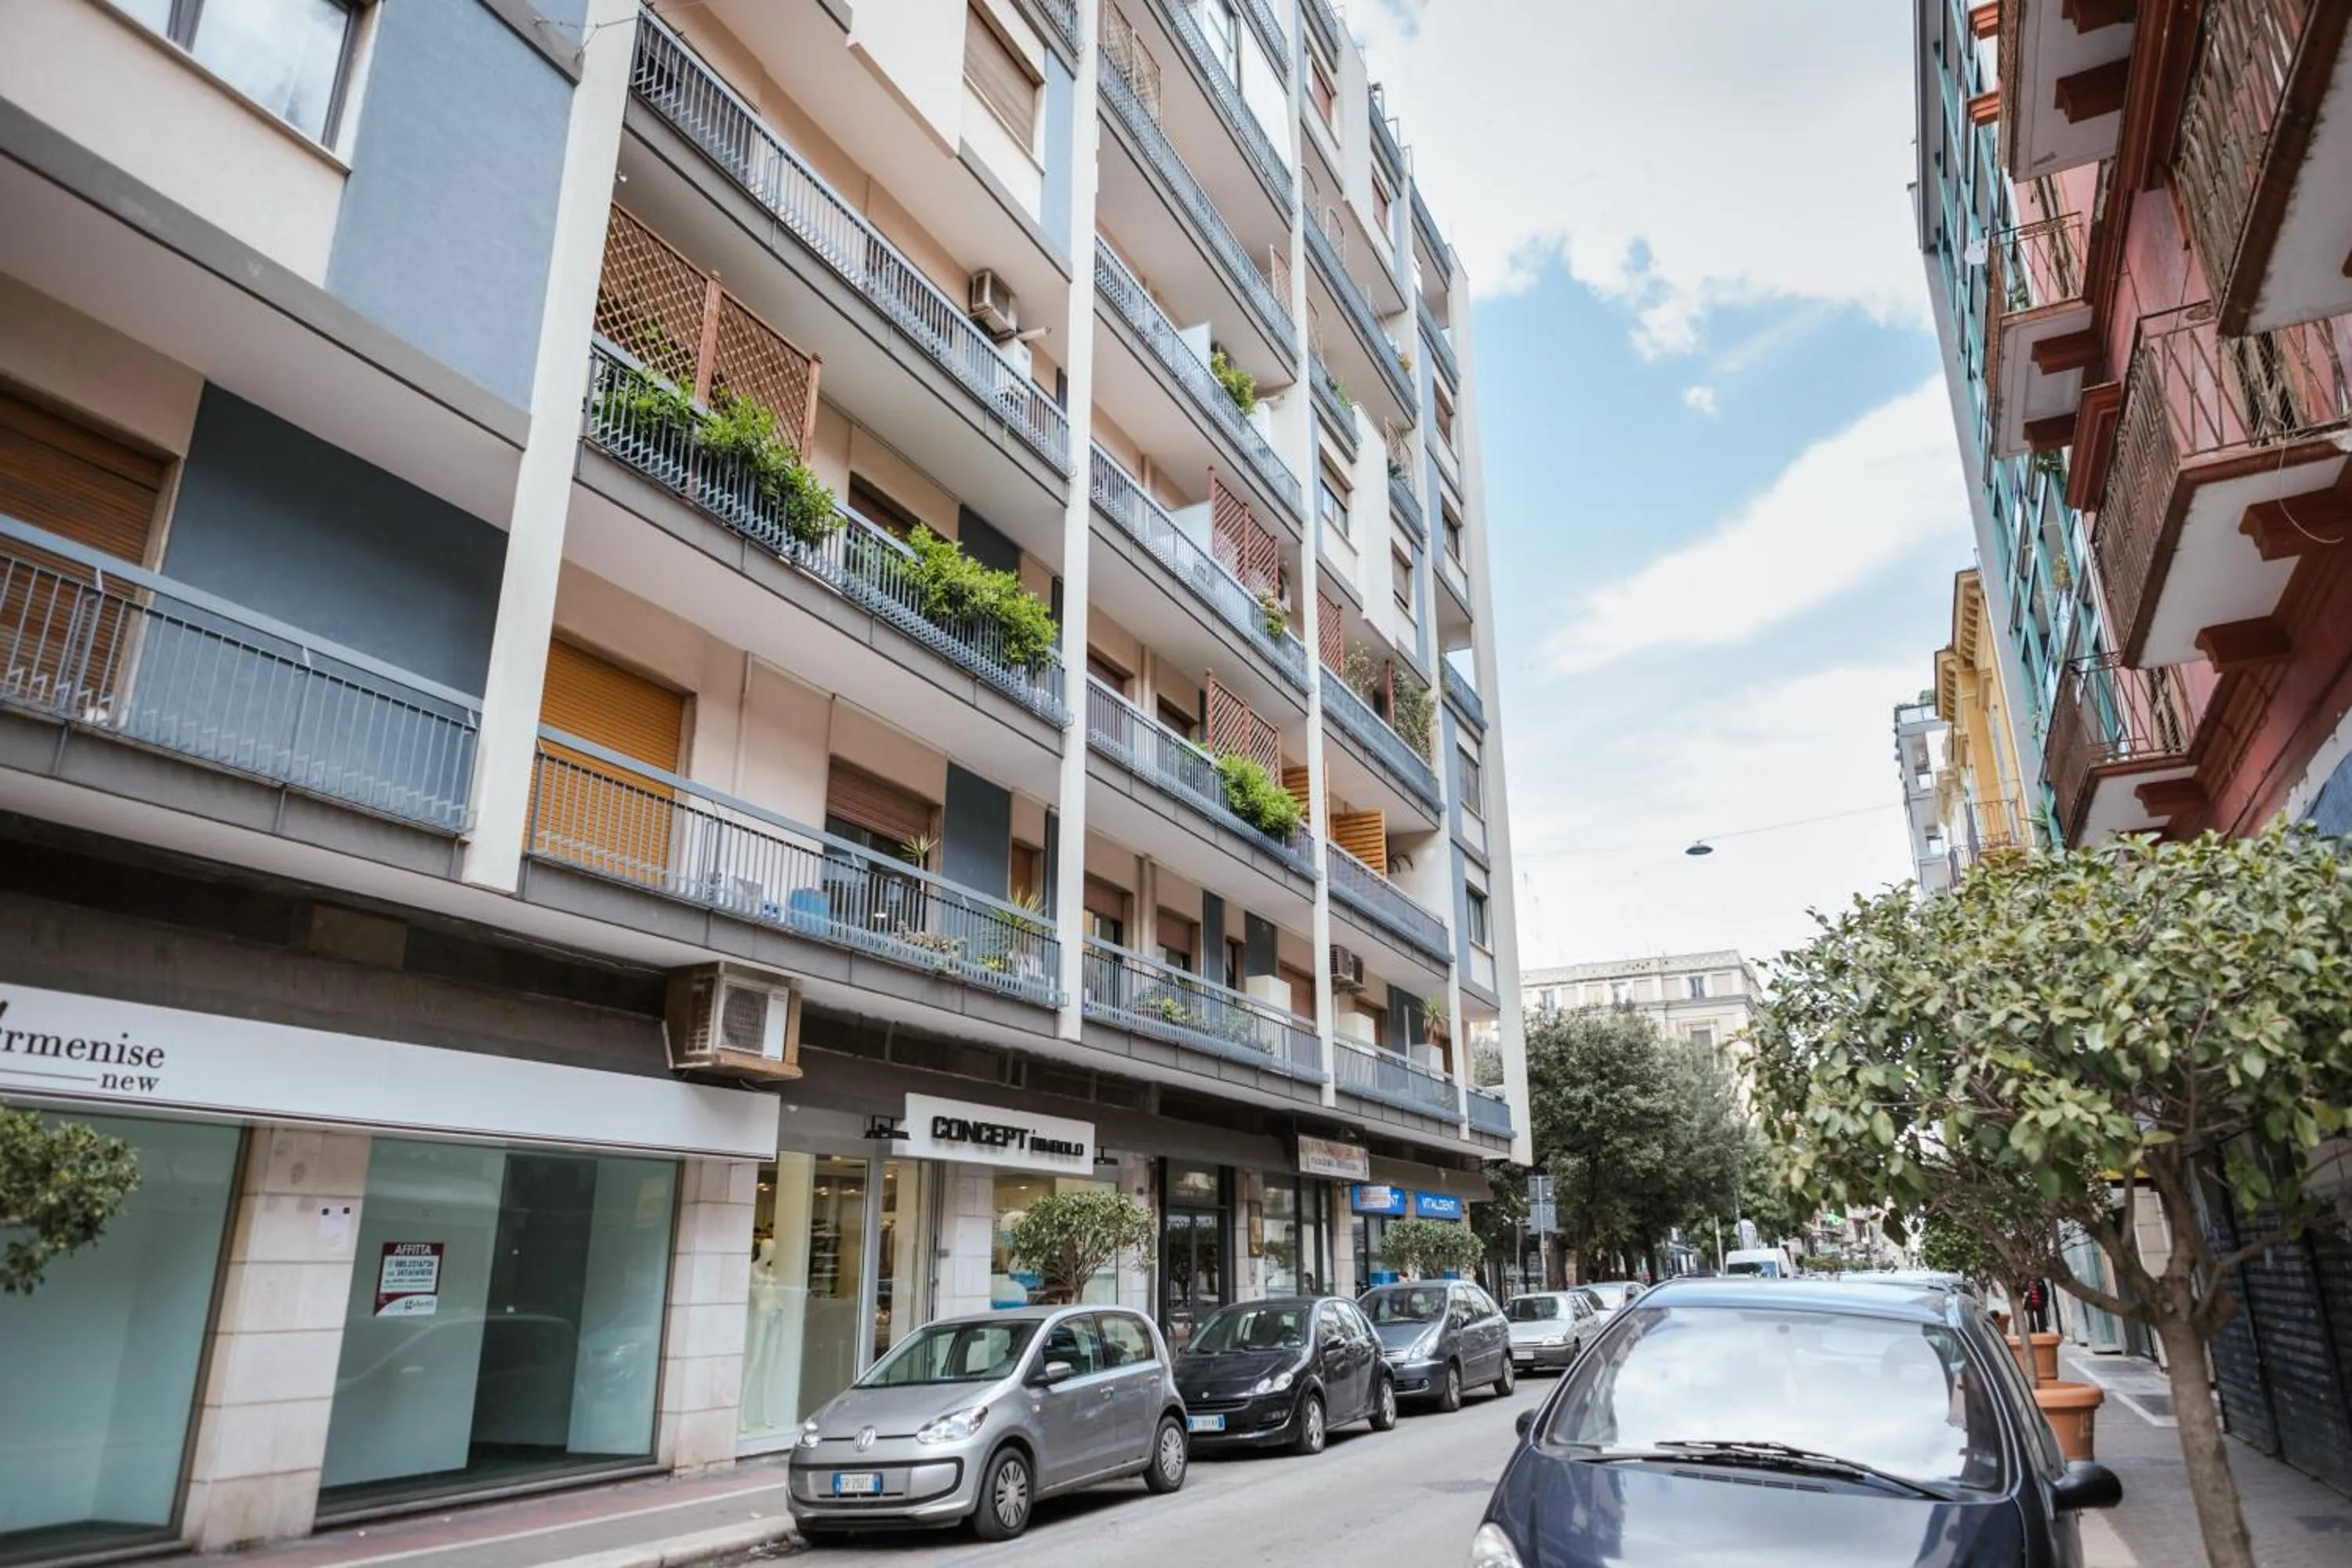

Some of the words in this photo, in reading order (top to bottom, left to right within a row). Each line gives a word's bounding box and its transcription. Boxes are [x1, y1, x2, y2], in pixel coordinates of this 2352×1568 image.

[0, 1000, 165, 1069] rmenise
[100, 1073, 160, 1093] new
[931, 1115, 1029, 1150] CONCEPT
[394, 1244, 431, 1255] AFFITTA
